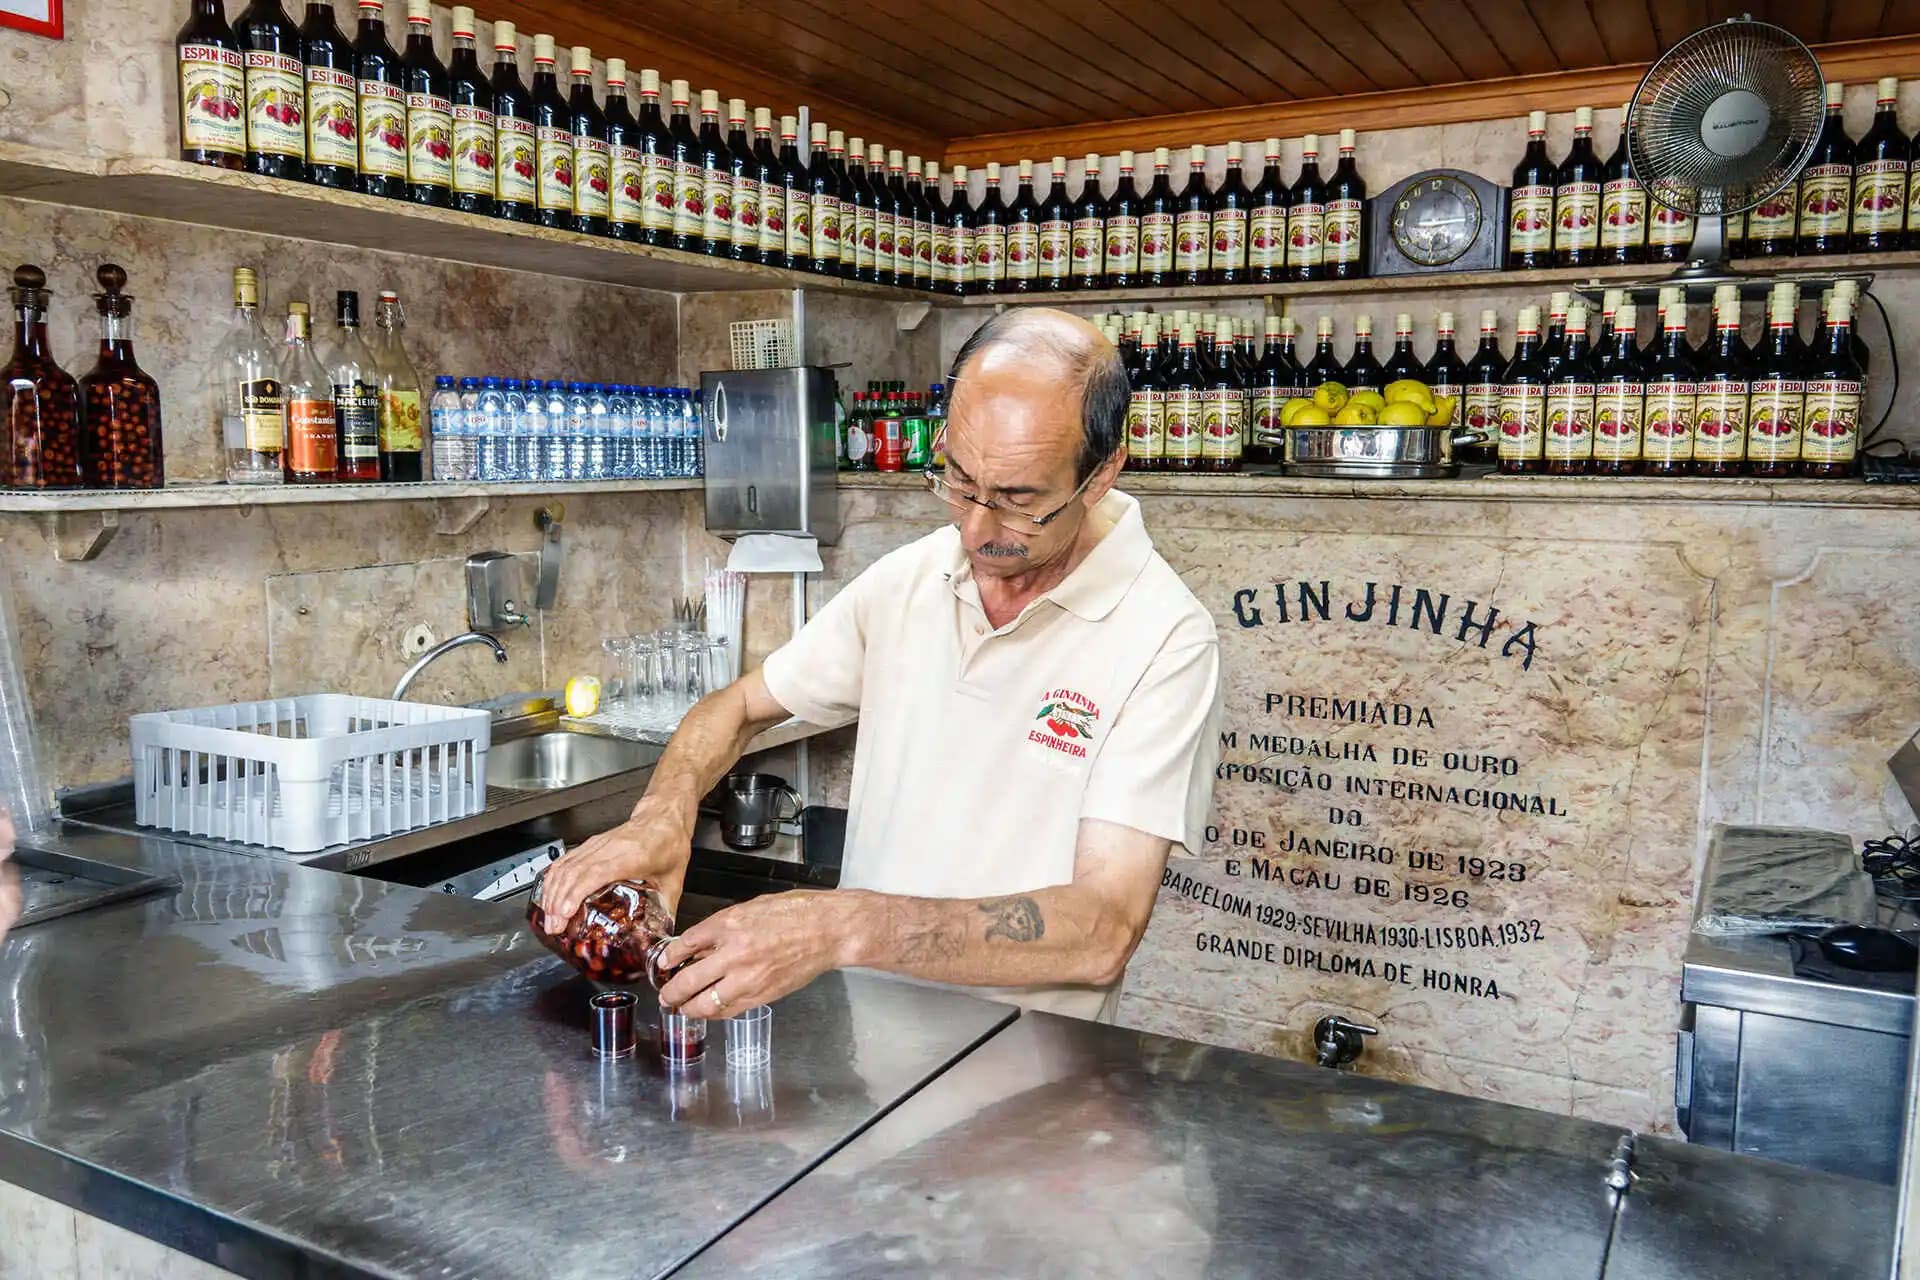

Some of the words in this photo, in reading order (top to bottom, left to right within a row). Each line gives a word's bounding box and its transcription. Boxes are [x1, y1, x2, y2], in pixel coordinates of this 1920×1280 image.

[1231, 580, 1538, 672] GINJINHA
[1264, 692, 1435, 729] PREMIADA
[1028, 730, 1087, 758] ESPINHEIRA
[1219, 731, 1237, 748] M
[1250, 733, 1378, 762] MEDALHA
[1393, 746, 1429, 767] DE
[1443, 752, 1518, 776] OURO
[1328, 806, 1362, 827] DO
[1346, 775, 1567, 816] INTERNACIONAL
[1232, 828, 1266, 849] DE
[1280, 830, 1394, 865] JANEIRO
[1408, 850, 1445, 871] DE
[1458, 856, 1527, 882] 1923
[1161, 867, 1251, 919] BARCELONA
[1225, 859, 1241, 876] E
[1251, 858, 1341, 890] MACAU
[1355, 877, 1390, 898] DE
[1404, 882, 1470, 909] 1926
[1196, 932, 1275, 963] GRANDE
[1283, 946, 1377, 978] DIPLOMA
[1384, 962, 1413, 985] DE
[1423, 968, 1500, 1000] HONRA
